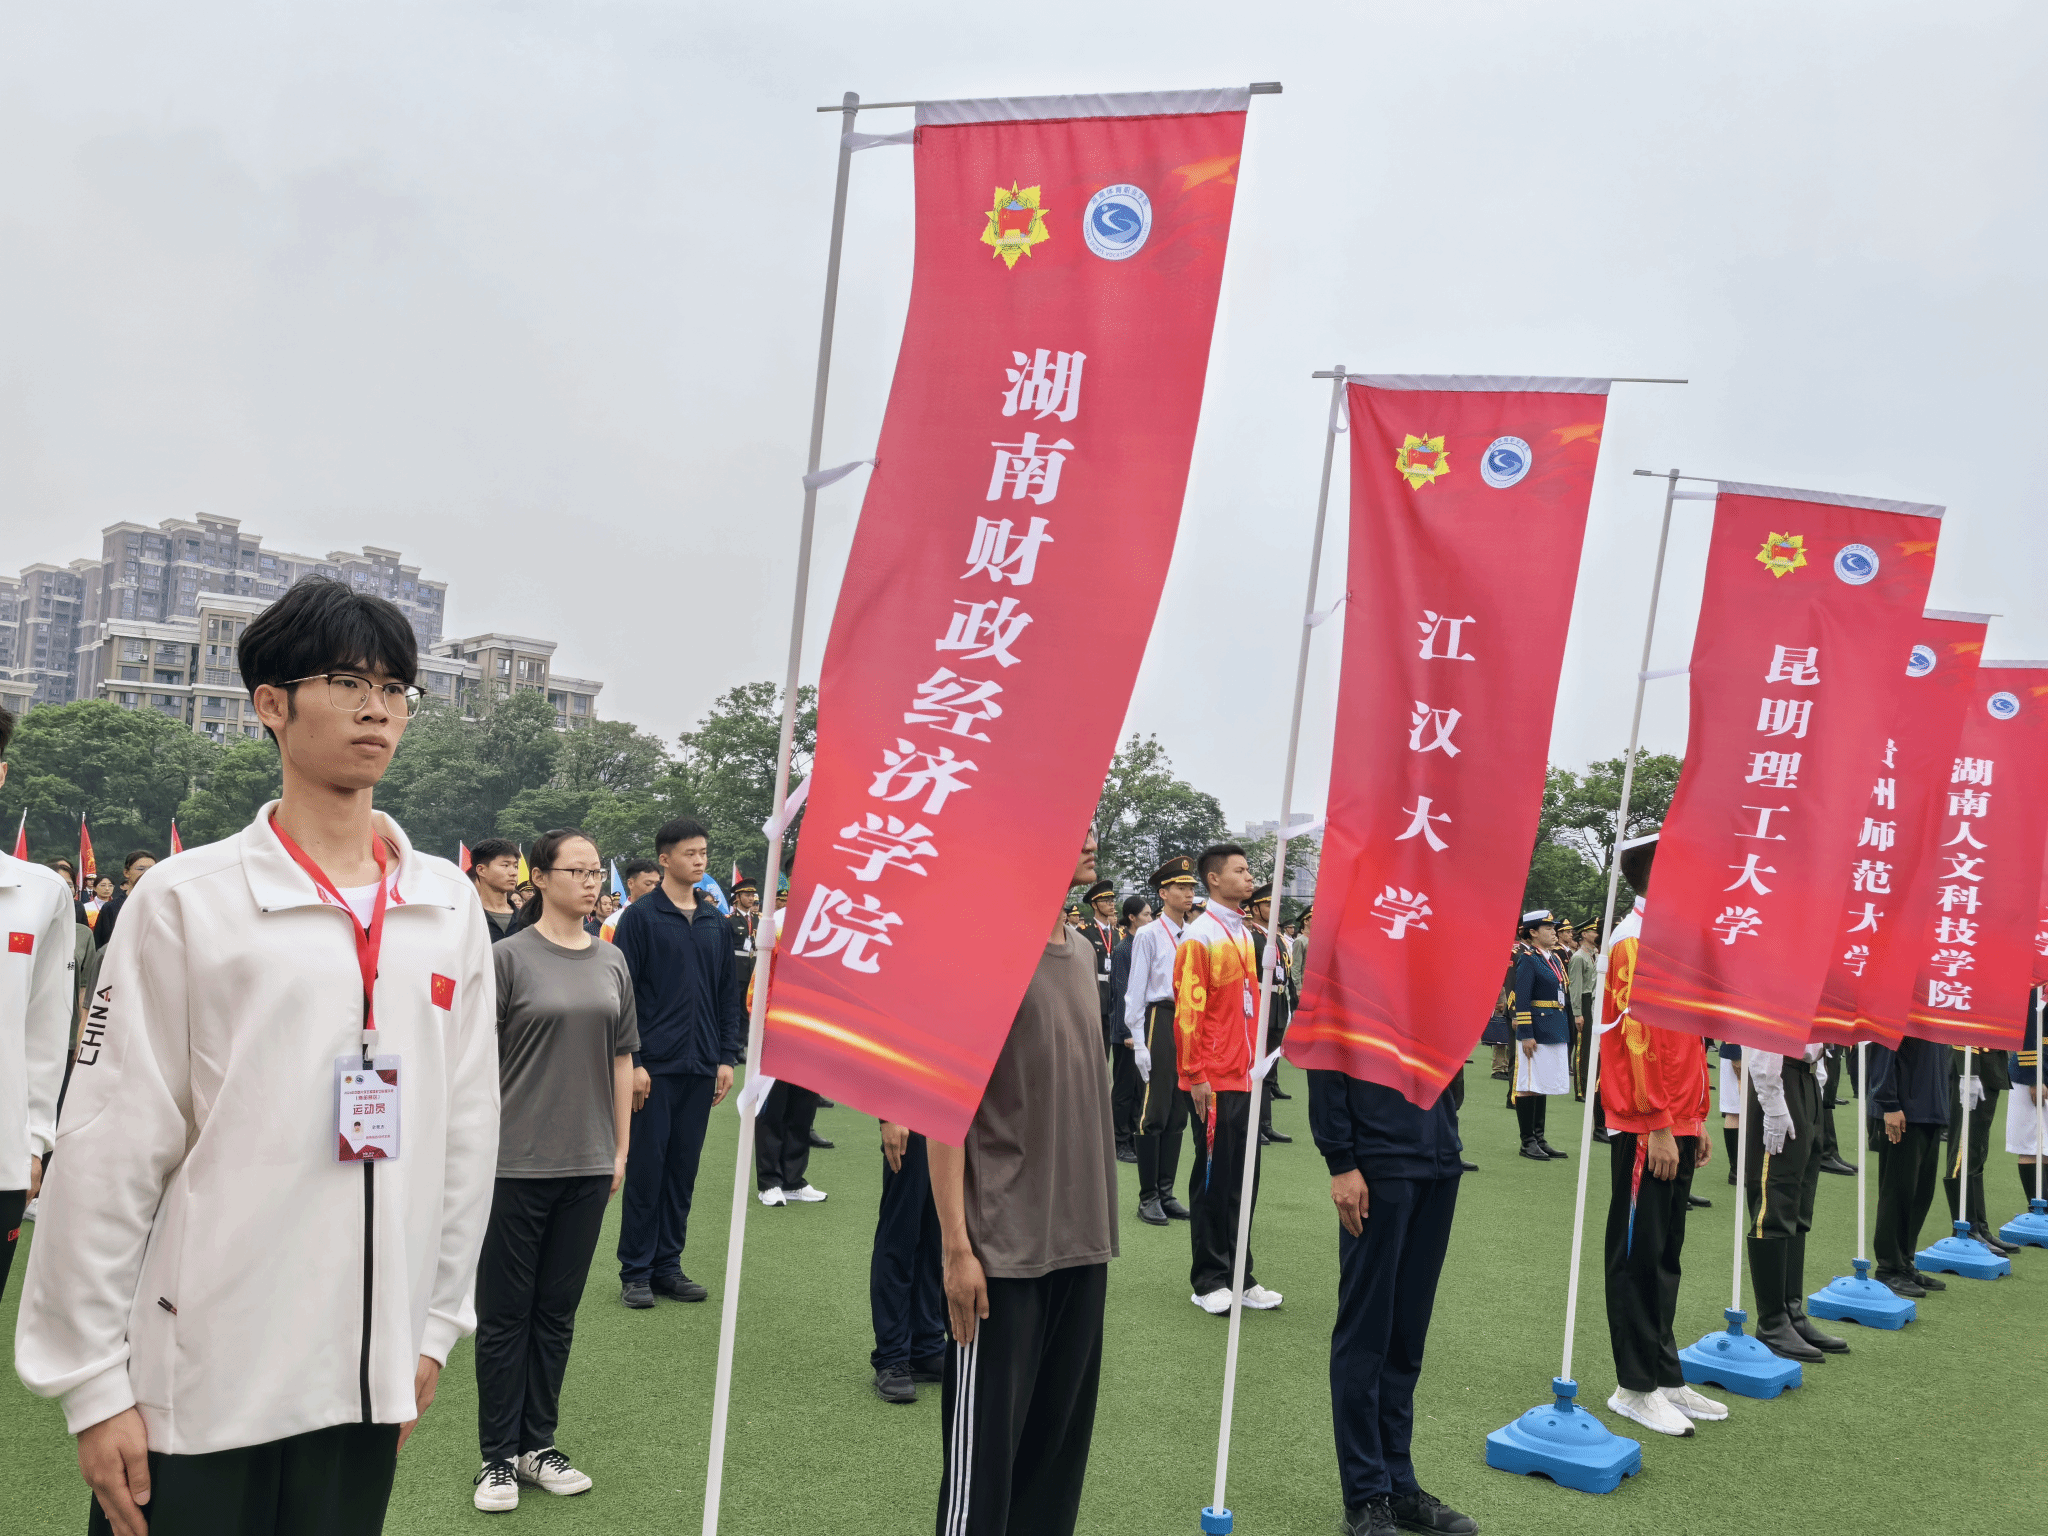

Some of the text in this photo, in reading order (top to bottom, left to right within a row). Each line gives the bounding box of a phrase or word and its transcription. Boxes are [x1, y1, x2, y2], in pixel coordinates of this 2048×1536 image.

[791, 348, 1086, 974] 湖南财政经济学院
[1370, 610, 1476, 940] 江汉大学
[1712, 644, 1820, 946] 昆明理工大学
[1928, 757, 1994, 1011] 湖南人文科技学院
[77, 985, 112, 1066] CHINA
[353, 1103, 386, 1115] 运动员
